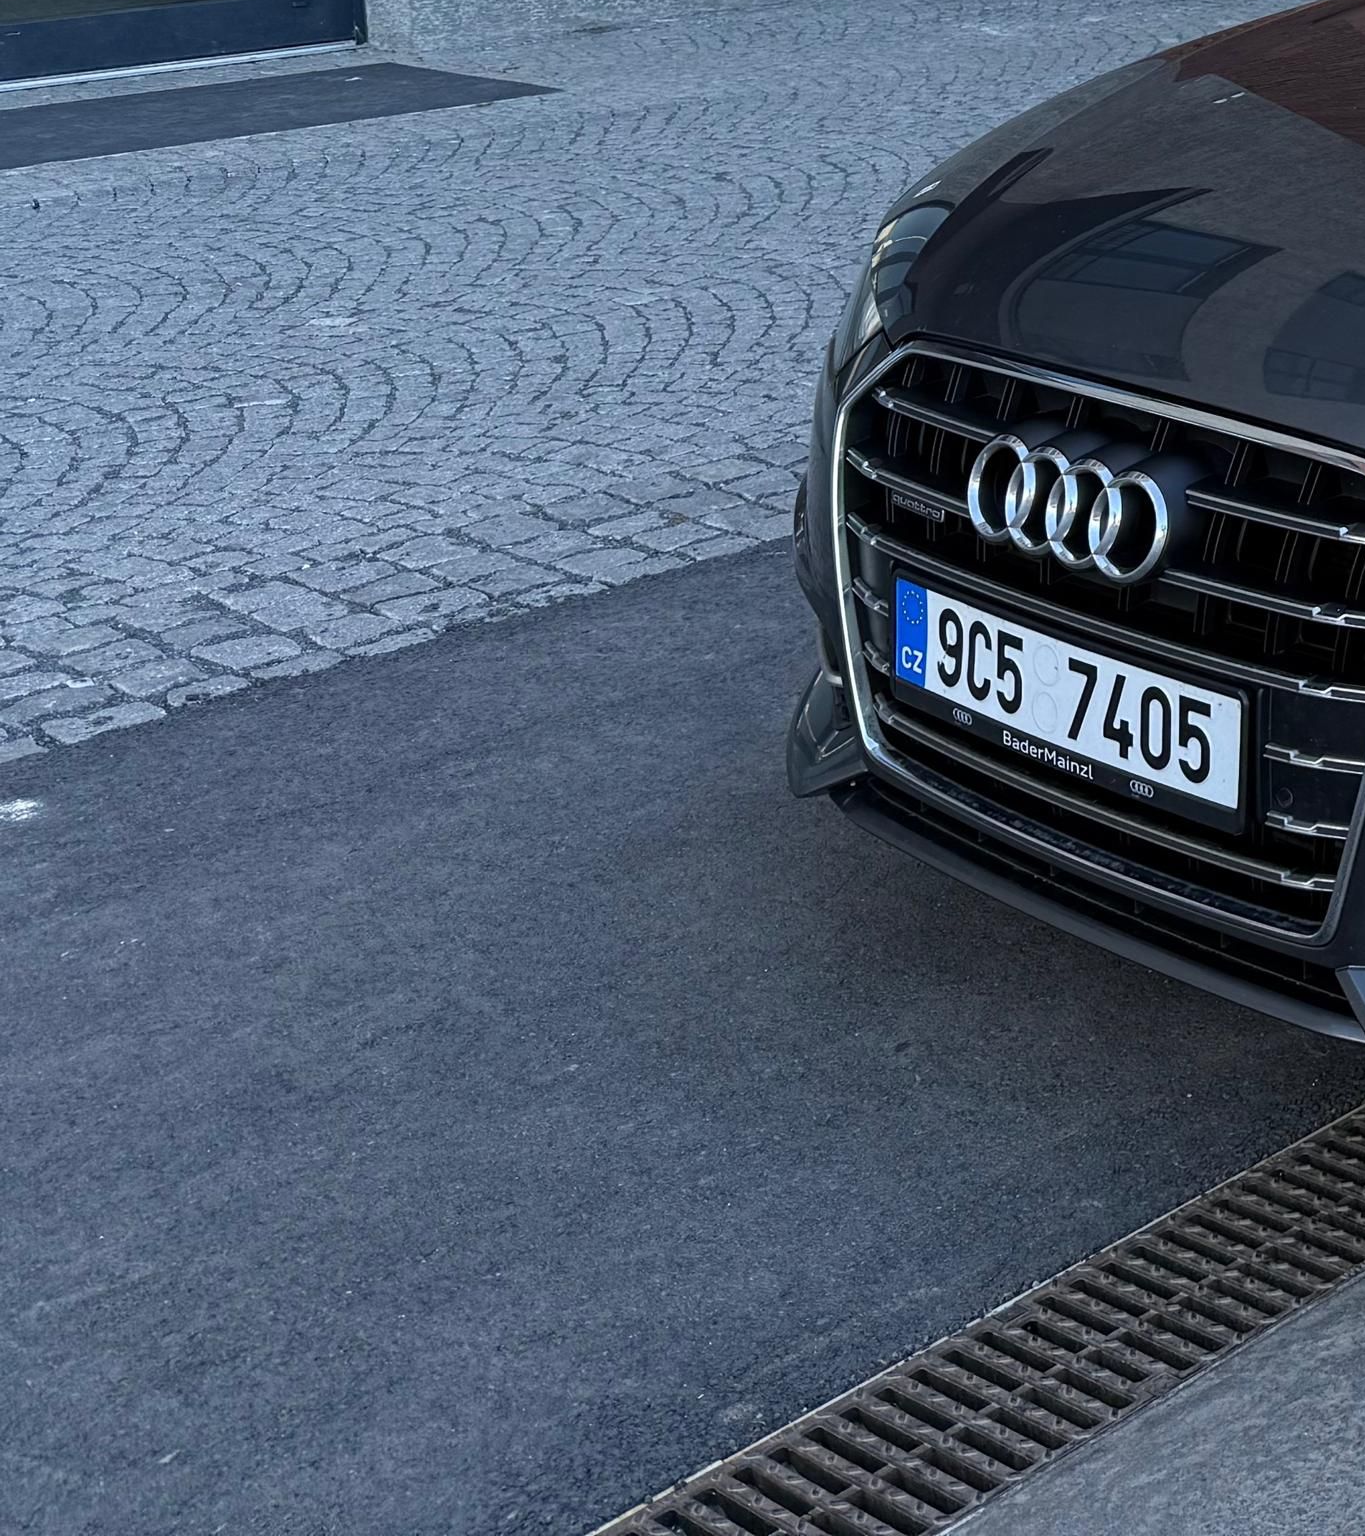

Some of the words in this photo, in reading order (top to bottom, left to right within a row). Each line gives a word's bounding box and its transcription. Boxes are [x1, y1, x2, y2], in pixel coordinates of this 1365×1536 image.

[892, 494, 941, 518] quattro
[902, 646, 923, 674] CZ
[937, 608, 1024, 715] 9C5
[1067, 656, 1212, 784] 7405
[1003, 730, 1094, 780] BaderMainzl
